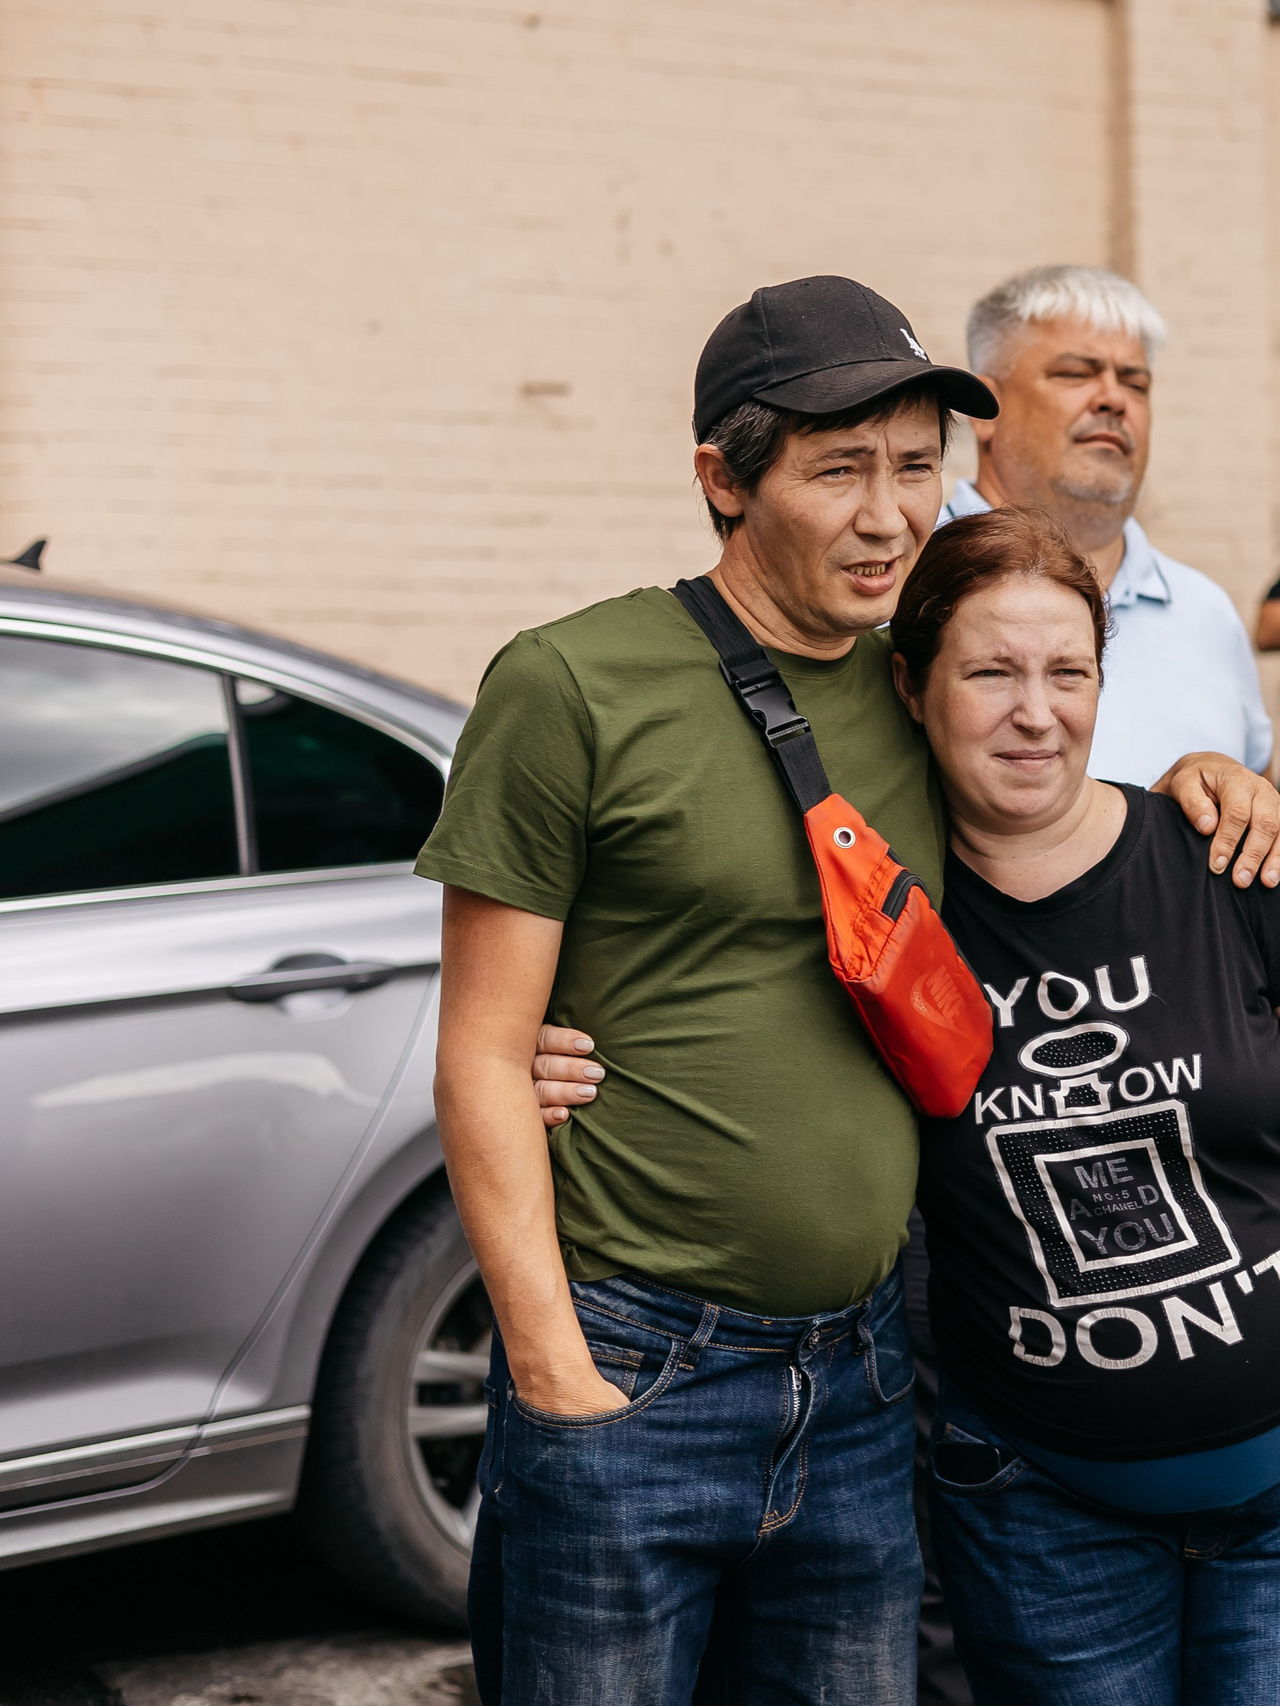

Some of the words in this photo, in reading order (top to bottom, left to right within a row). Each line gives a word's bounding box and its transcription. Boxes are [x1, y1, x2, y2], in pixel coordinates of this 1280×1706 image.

[926, 964, 966, 1020] NIKE
[984, 955, 1151, 1027] YOU
[1074, 1157, 1134, 1189] ME
[1094, 1200, 1143, 1217] CHANEL
[1079, 1212, 1176, 1255] YOU
